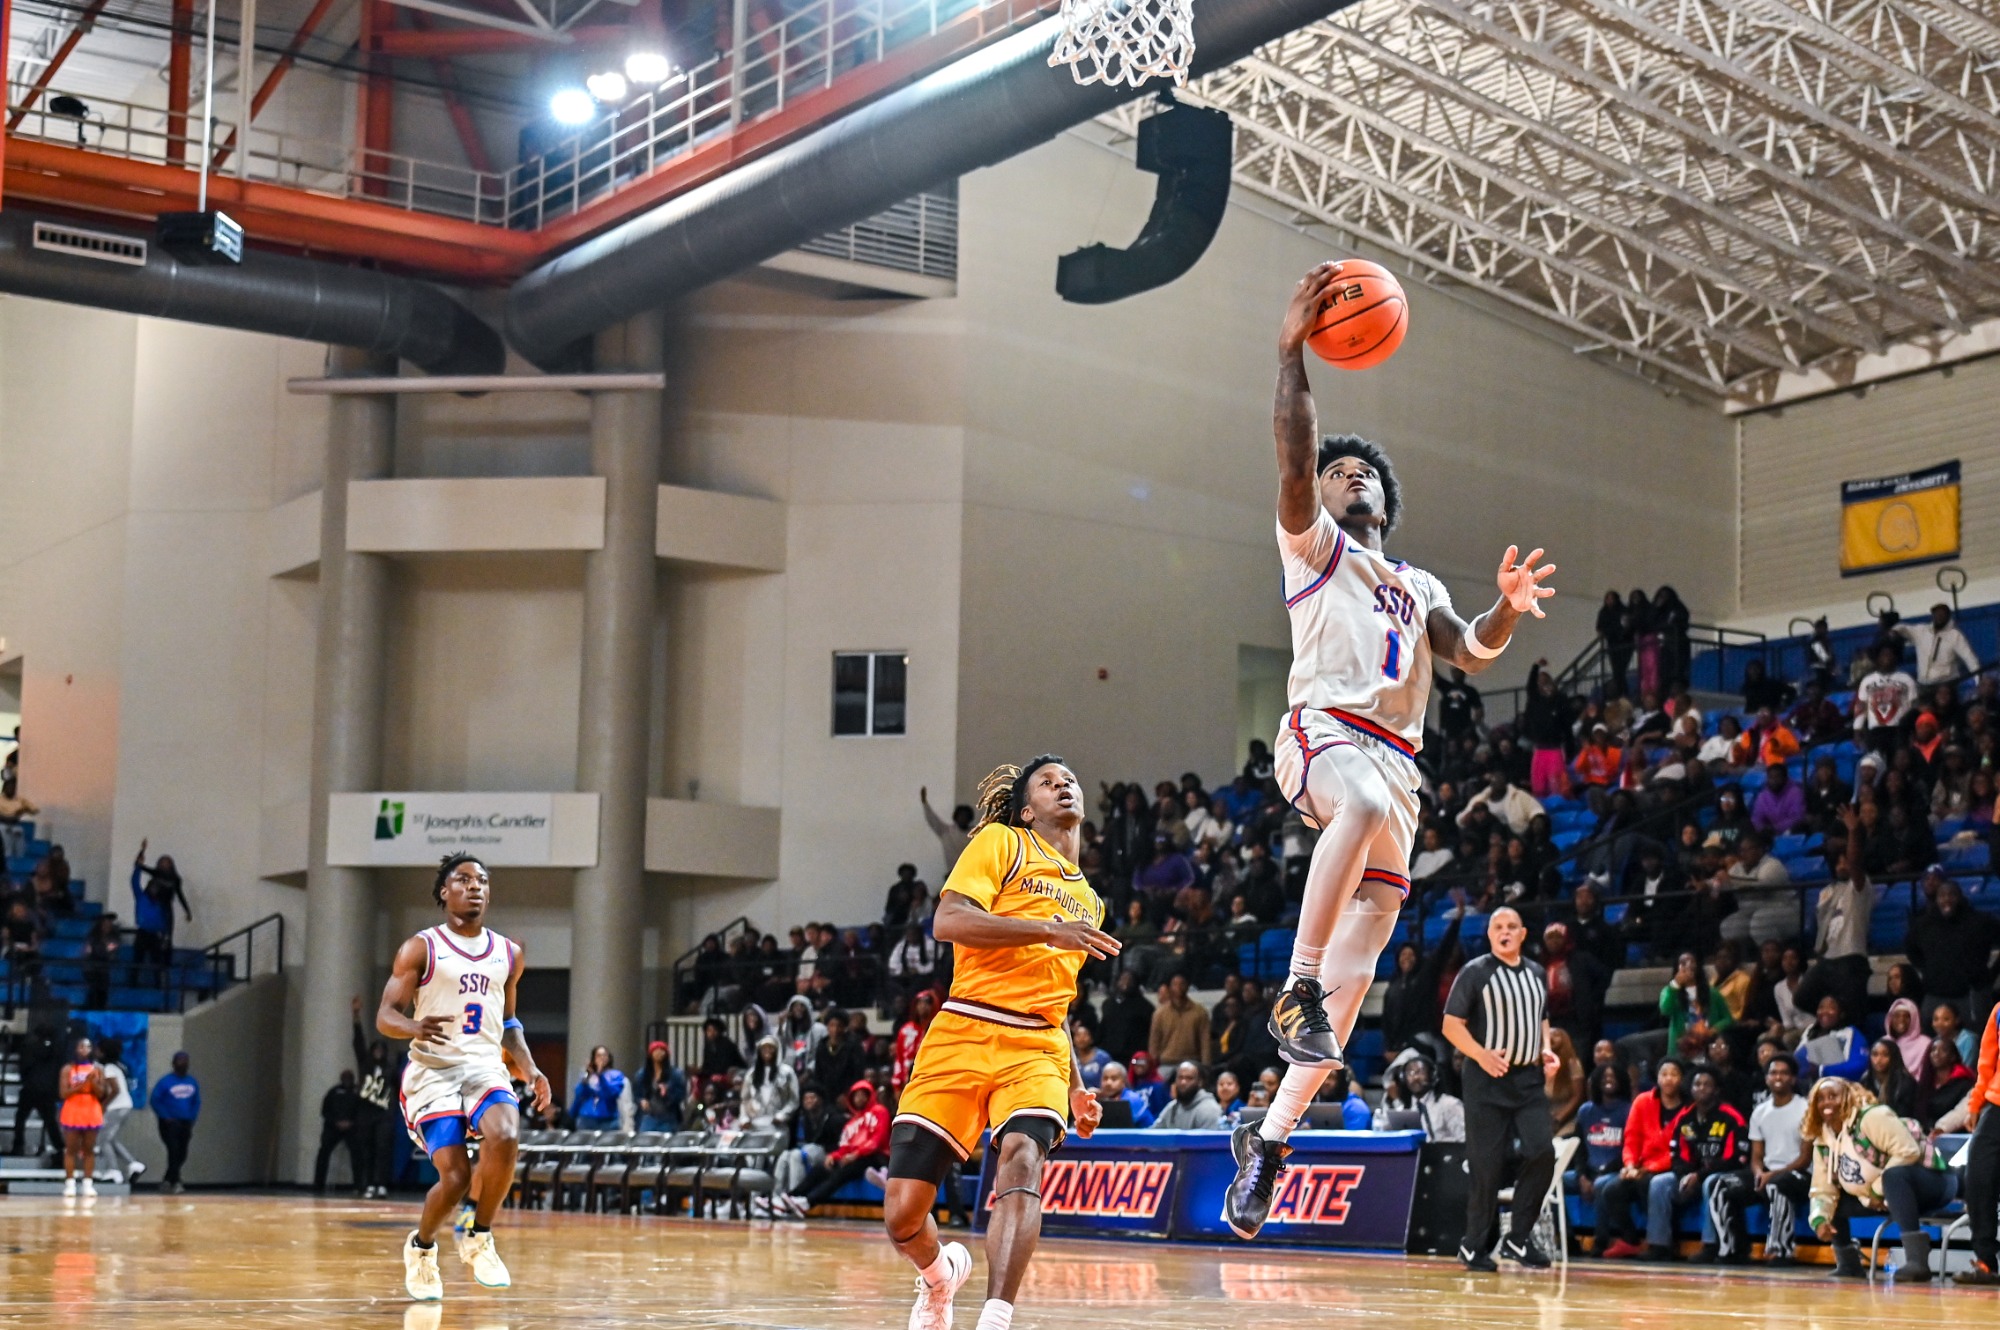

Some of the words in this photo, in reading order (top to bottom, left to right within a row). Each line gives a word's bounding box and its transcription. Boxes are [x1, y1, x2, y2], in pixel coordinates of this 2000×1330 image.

[1373, 583, 1417, 626] SSU
[1381, 628, 1401, 682] 1
[458, 972, 491, 996] SSU
[462, 1002, 484, 1035] 3
[984, 1159, 1174, 1218] VANNAH
[1220, 1164, 1366, 1225] ATE
